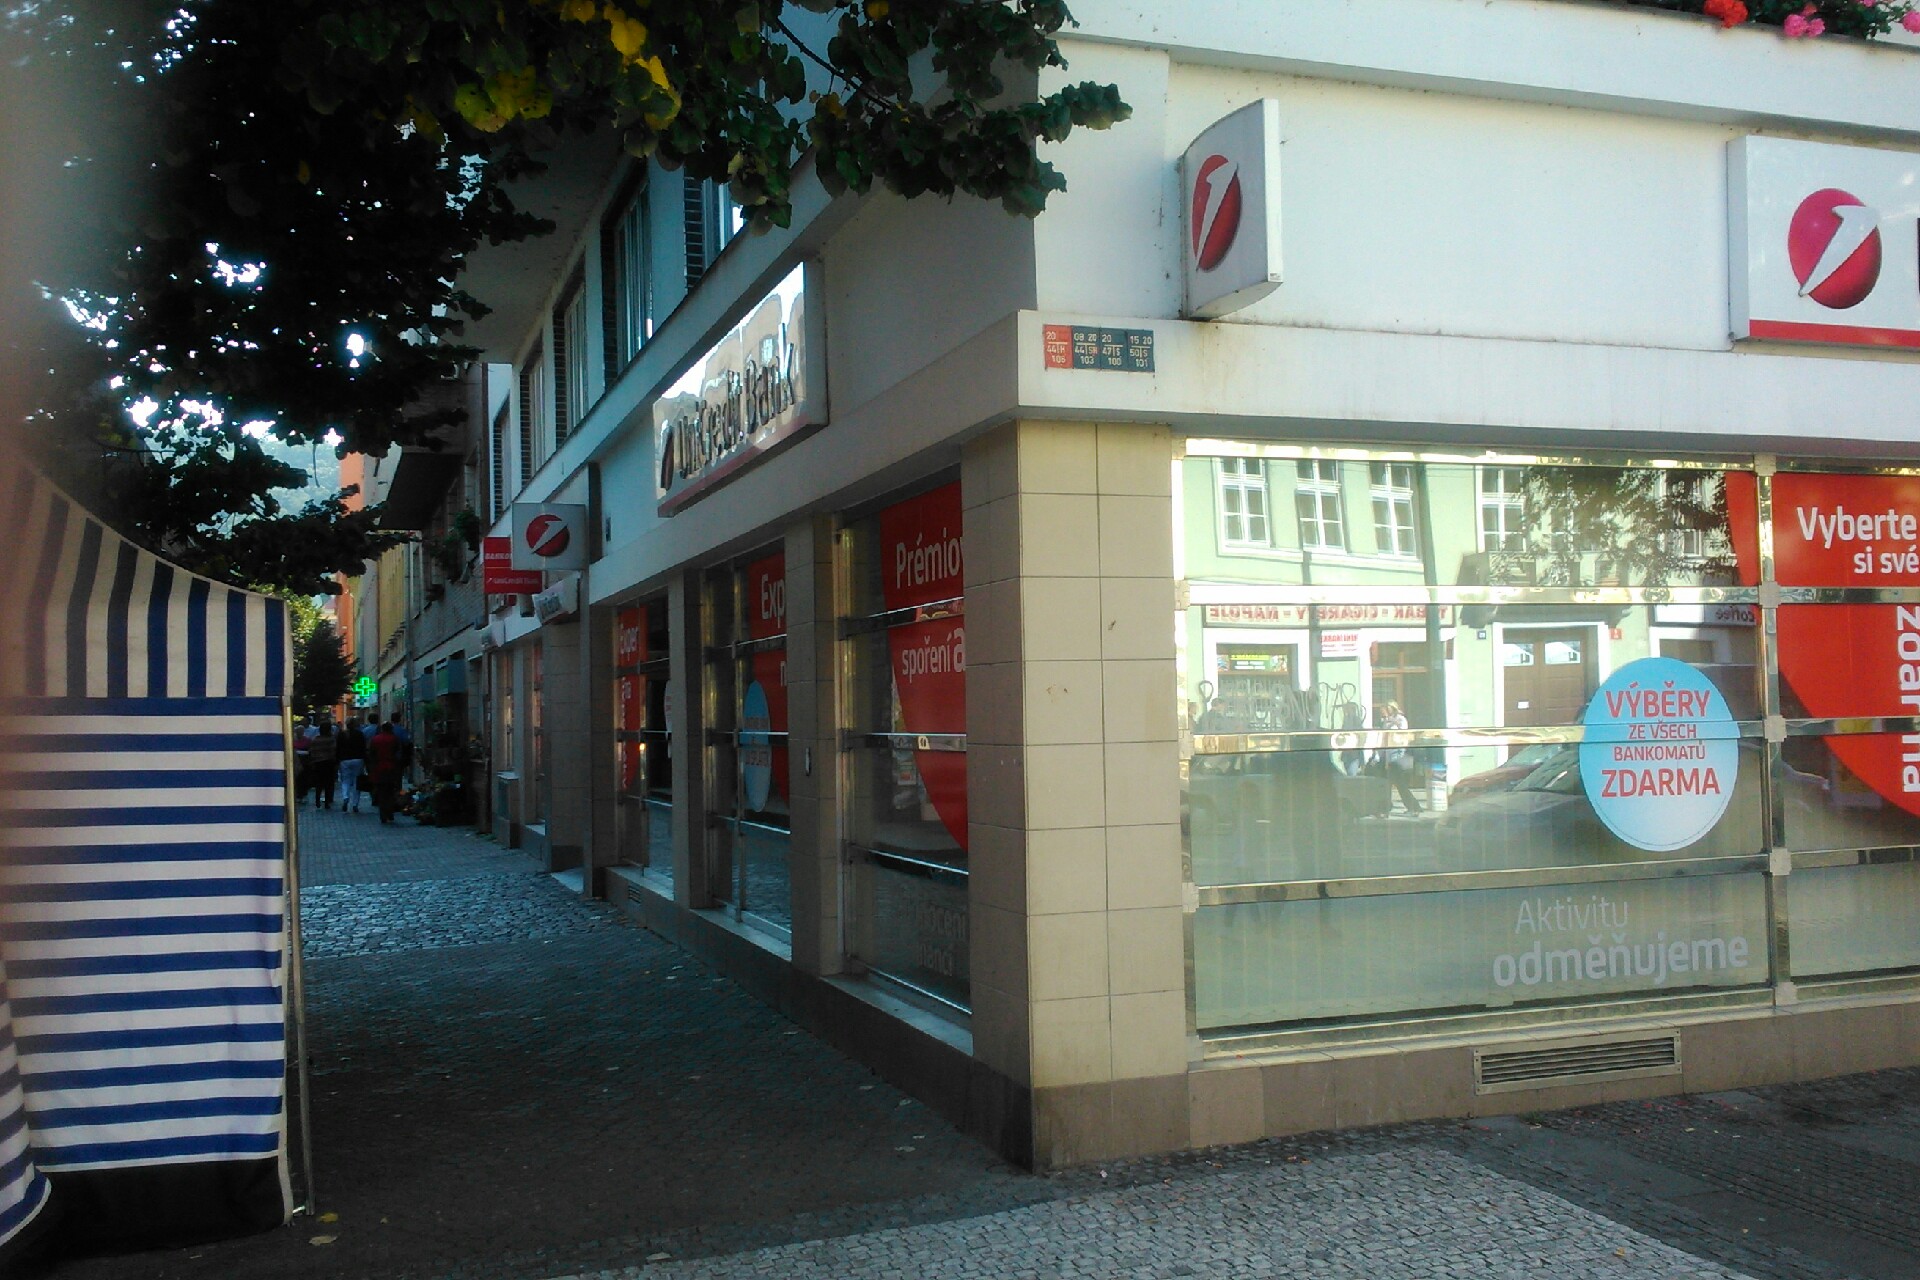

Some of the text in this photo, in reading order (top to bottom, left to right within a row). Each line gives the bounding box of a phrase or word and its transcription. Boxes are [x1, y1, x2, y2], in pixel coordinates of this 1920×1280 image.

[1796, 505, 1917, 549] Vyberte
[896, 527, 964, 589] Prémio
[1853, 544, 1920, 574] si své
[902, 635, 950, 683] spoření
[1606, 680, 1711, 718] VÝBĚRY
[1629, 719, 1697, 739] ZE VŠECH
[1614, 741, 1706, 761] BANKOMATŮ
[1601, 767, 1721, 798] ZDARMA
[1514, 895, 1630, 935] Aktivitu
[1493, 930, 1749, 988] odměňujeme
